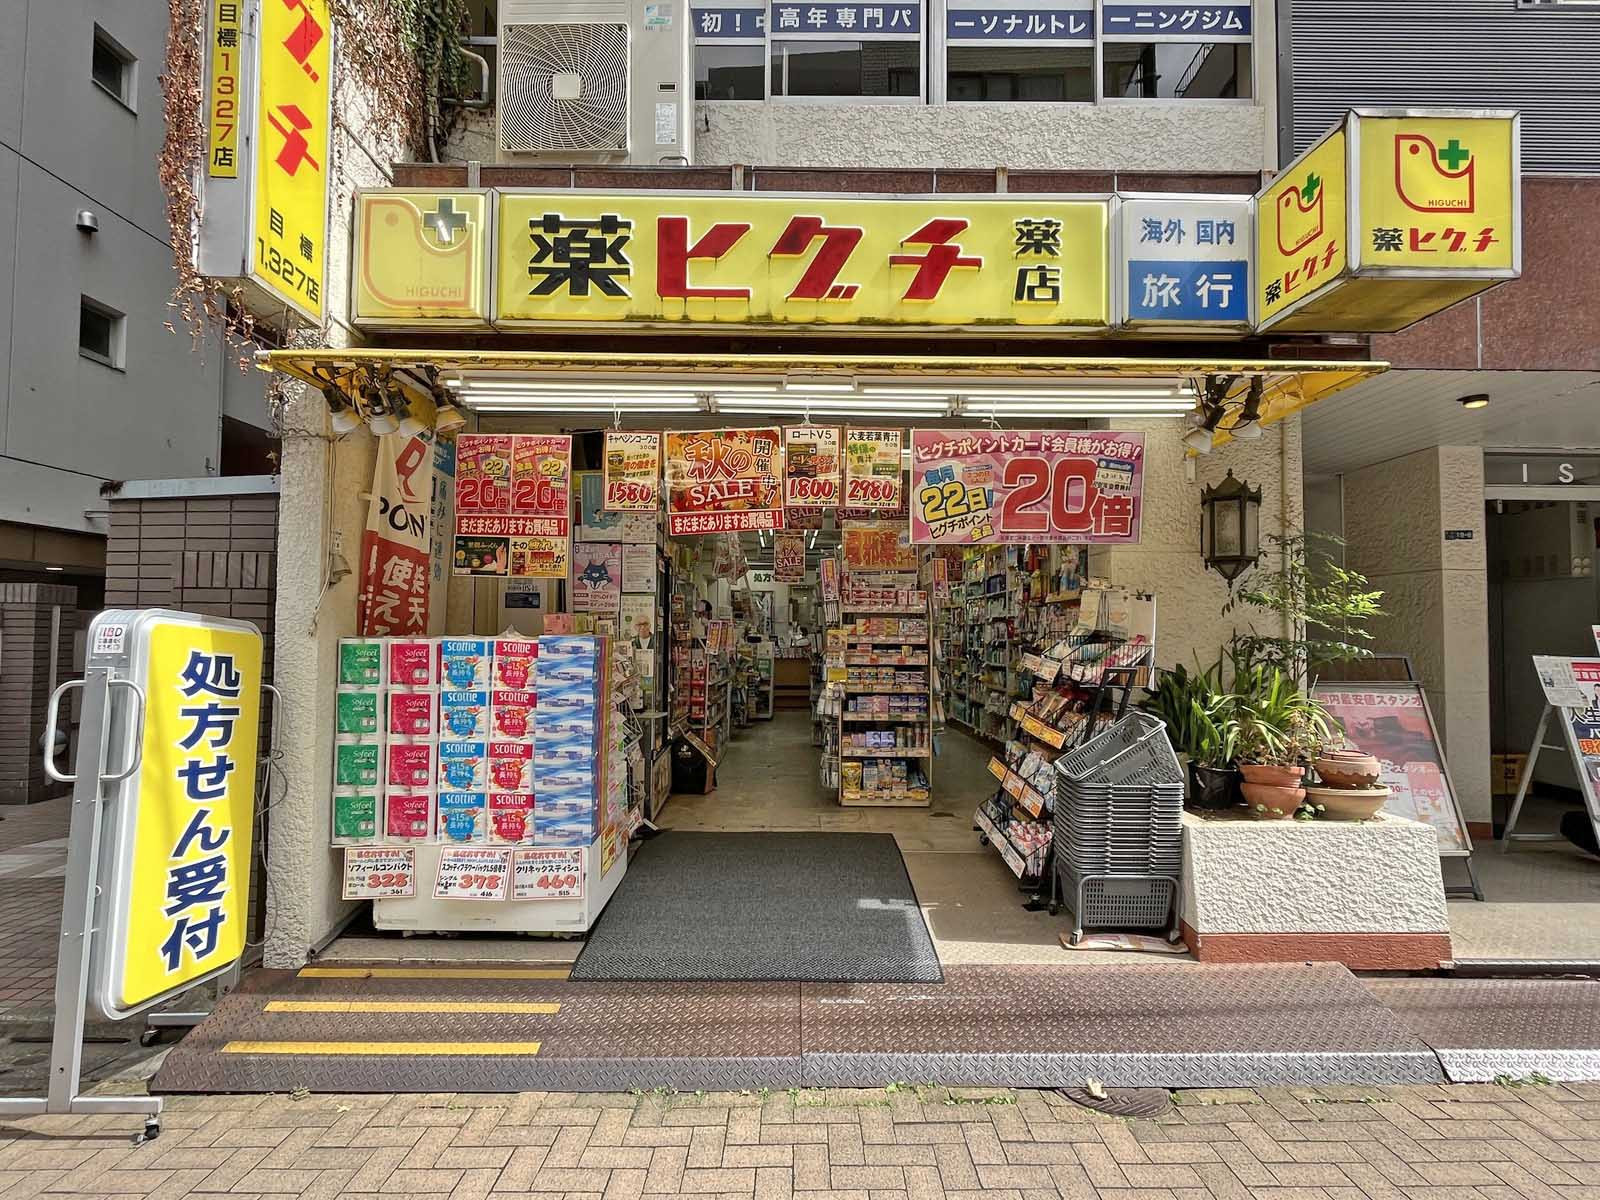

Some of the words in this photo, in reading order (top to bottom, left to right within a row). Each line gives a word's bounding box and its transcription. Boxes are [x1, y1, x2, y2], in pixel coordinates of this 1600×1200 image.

[1428, 199, 1467, 208] HIGUCHI
[257, 237, 319, 304] 1,327店
[1014, 219, 1062, 302] 薬店
[405, 286, 463, 298] HIGUCHI
[1141, 273, 1234, 308] 旅行
[690, 478, 754, 506] SALE
[789, 477, 835, 500] 1800
[848, 478, 895, 501] 2980
[929, 512, 993, 539] ヒグチポイント
[777, 559, 801, 568] SALE
[161, 650, 241, 972] 処方せん受付
[367, 873, 409, 888] 328
[458, 874, 501, 889] 378
[537, 874, 577, 890] 469
